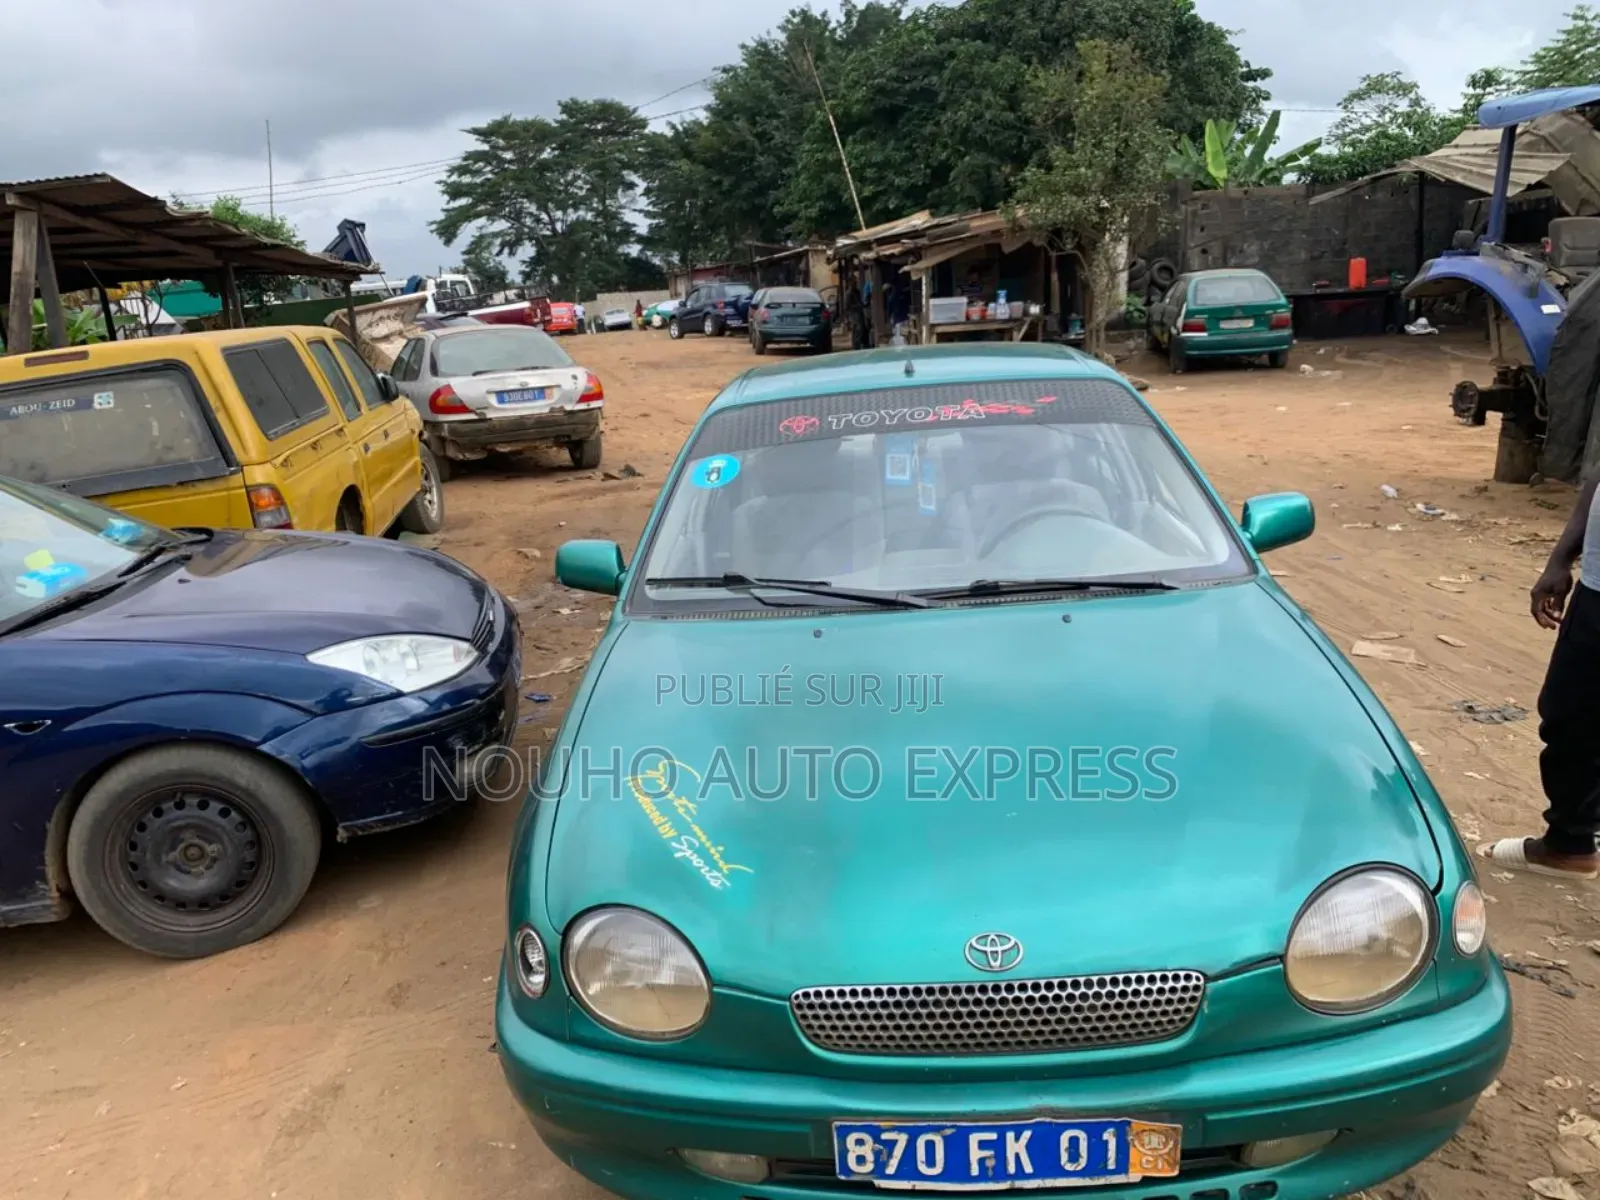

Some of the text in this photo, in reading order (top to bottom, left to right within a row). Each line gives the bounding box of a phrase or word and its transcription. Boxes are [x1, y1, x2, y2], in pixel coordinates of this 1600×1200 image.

[828, 403, 986, 430] TOYOTA
[659, 818, 678, 839] by
[670, 835, 732, 889] Sports
[845, 1128, 1118, 1177] 870 FK 01
